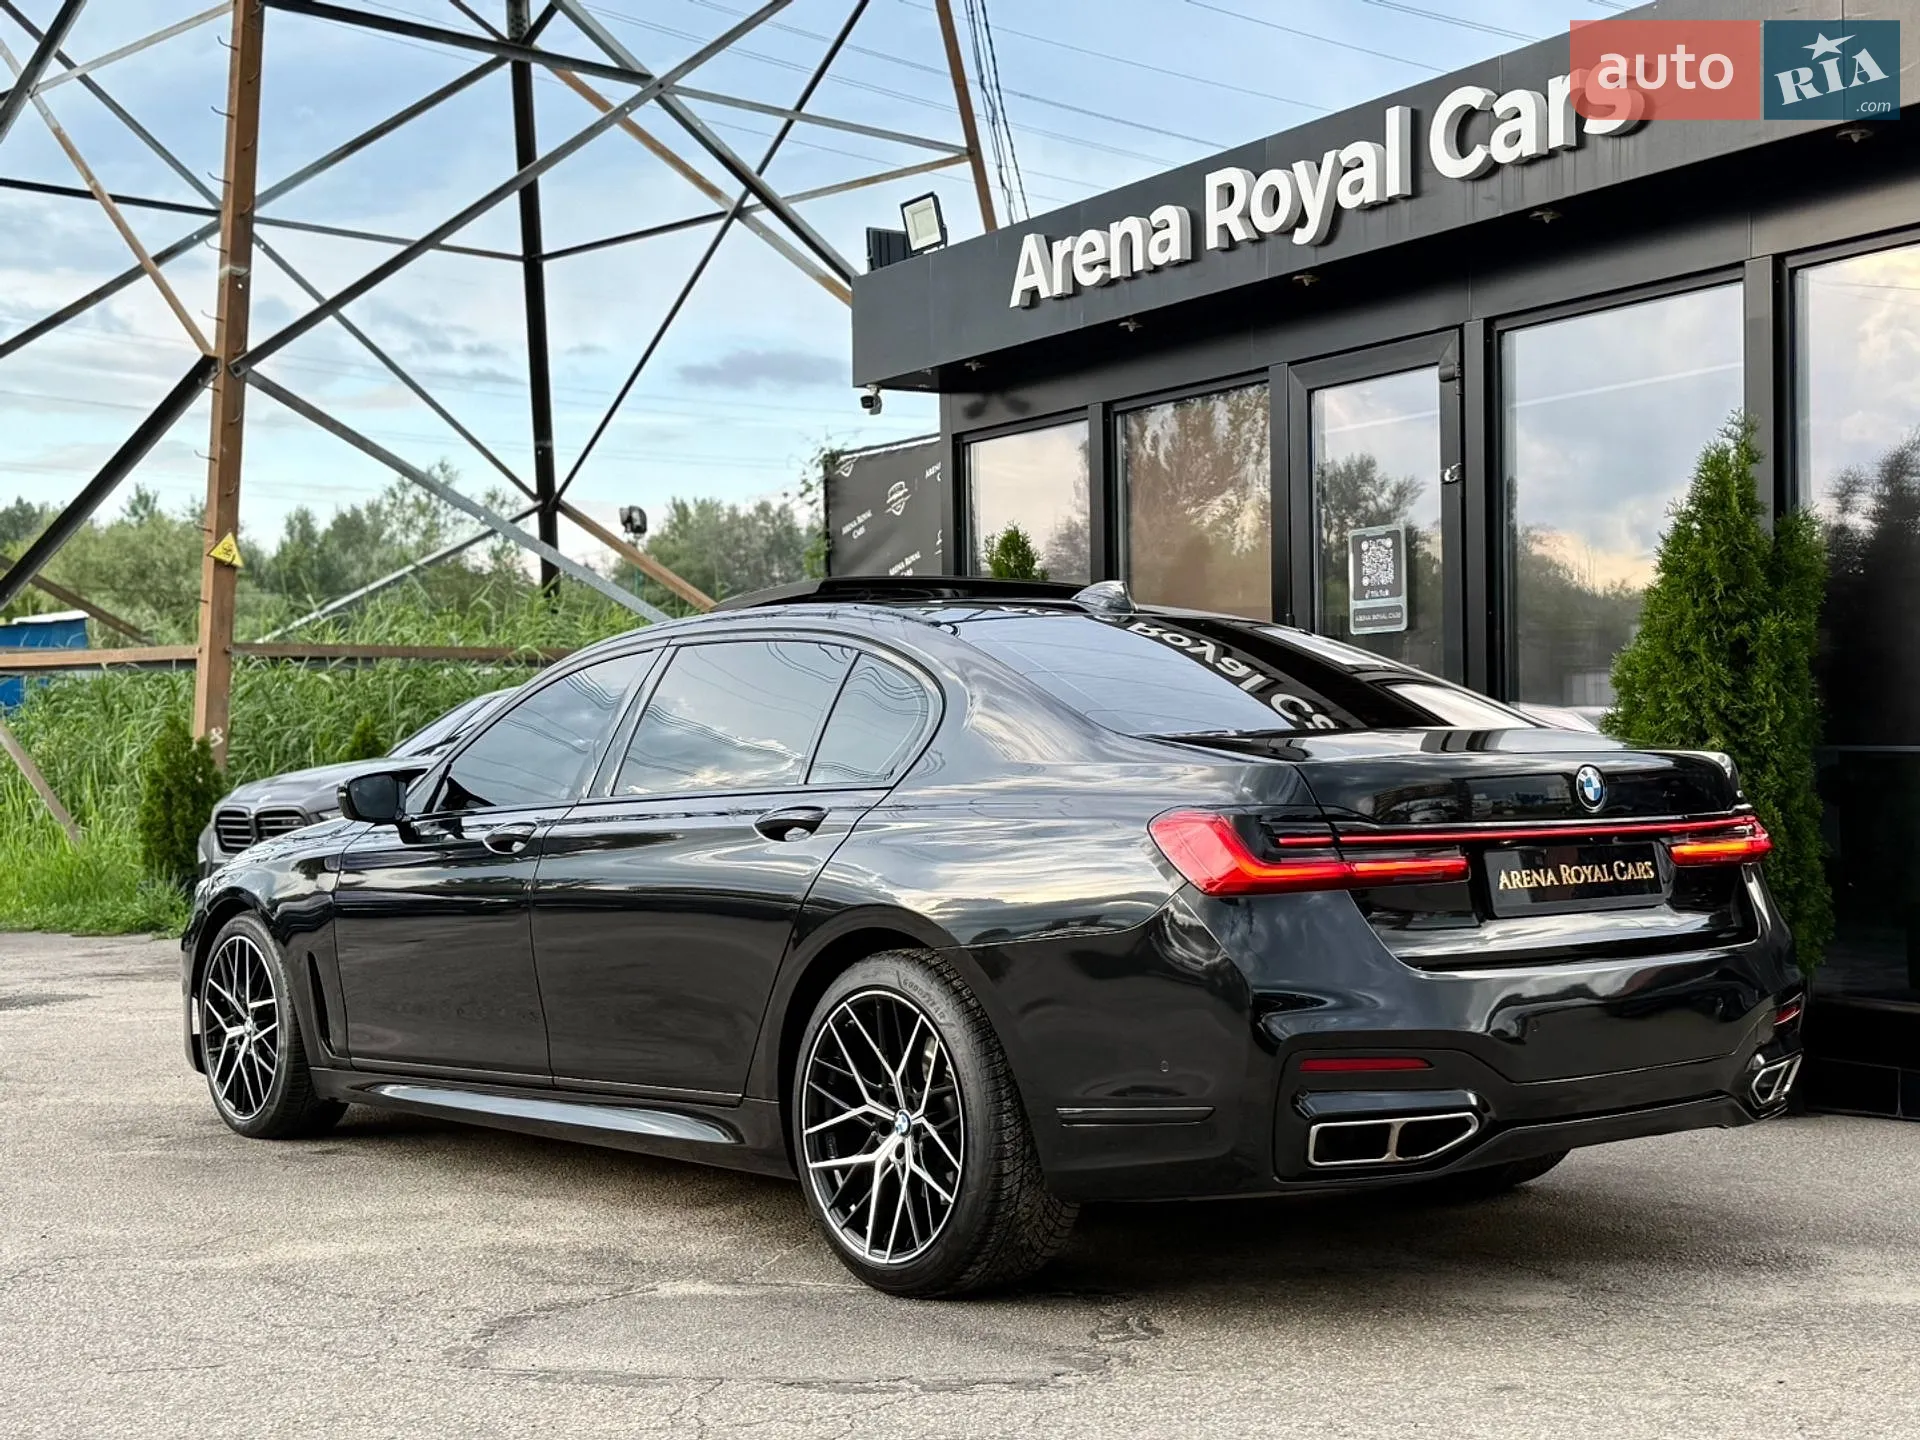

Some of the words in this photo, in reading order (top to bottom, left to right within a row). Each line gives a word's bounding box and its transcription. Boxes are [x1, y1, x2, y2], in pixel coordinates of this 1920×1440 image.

[1009, 204, 1192, 308] Arena
[1205, 105, 1412, 246] Royal
[1429, 57, 1645, 181] Cars
[1498, 868, 1558, 890] ARENA
[1559, 863, 1613, 885] ROYAL
[1613, 860, 1655, 881] CARS
[902, 978, 946, 1021] GOODYEAR
